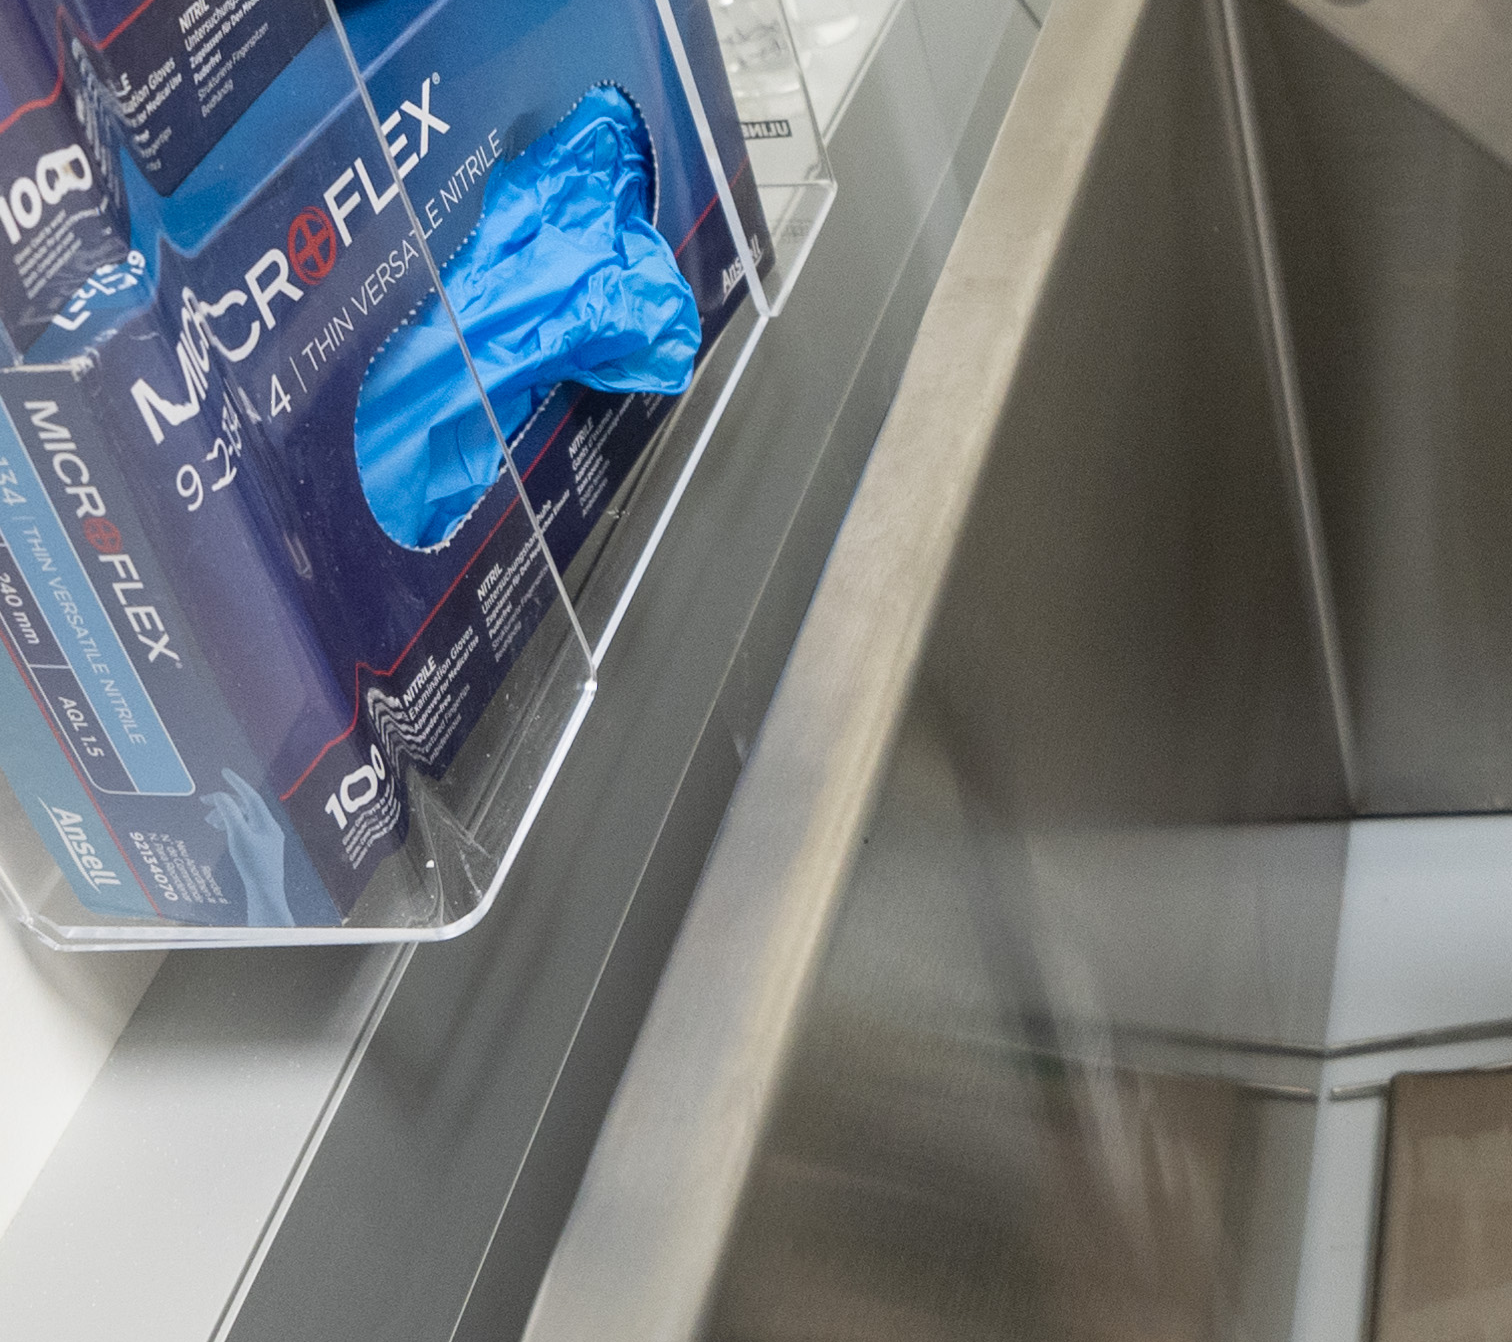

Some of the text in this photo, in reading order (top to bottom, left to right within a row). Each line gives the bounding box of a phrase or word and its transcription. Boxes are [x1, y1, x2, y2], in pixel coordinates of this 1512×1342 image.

[148, 57, 176, 90] Gloves
[301, 128, 504, 373] THIN VERSALE NITRILE
[477, 563, 503, 601] NITRIL
[12, 607, 40, 646] mm
[23, 525, 58, 572] THIN
[48, 577, 108, 677] VERSATILE
[100, 678, 148, 746] NITRILE
[402, 655, 437, 707] NITRILE
[409, 625, 473, 721] Examination Gloves
[414, 691, 442, 734] Approved
[448, 648, 470, 682] Medical
[468, 635, 481, 653] Use
[58, 695, 105, 758] AQL 1.5
[51, 806, 122, 887] Ansell
[129, 831, 179, 902] 92134070
